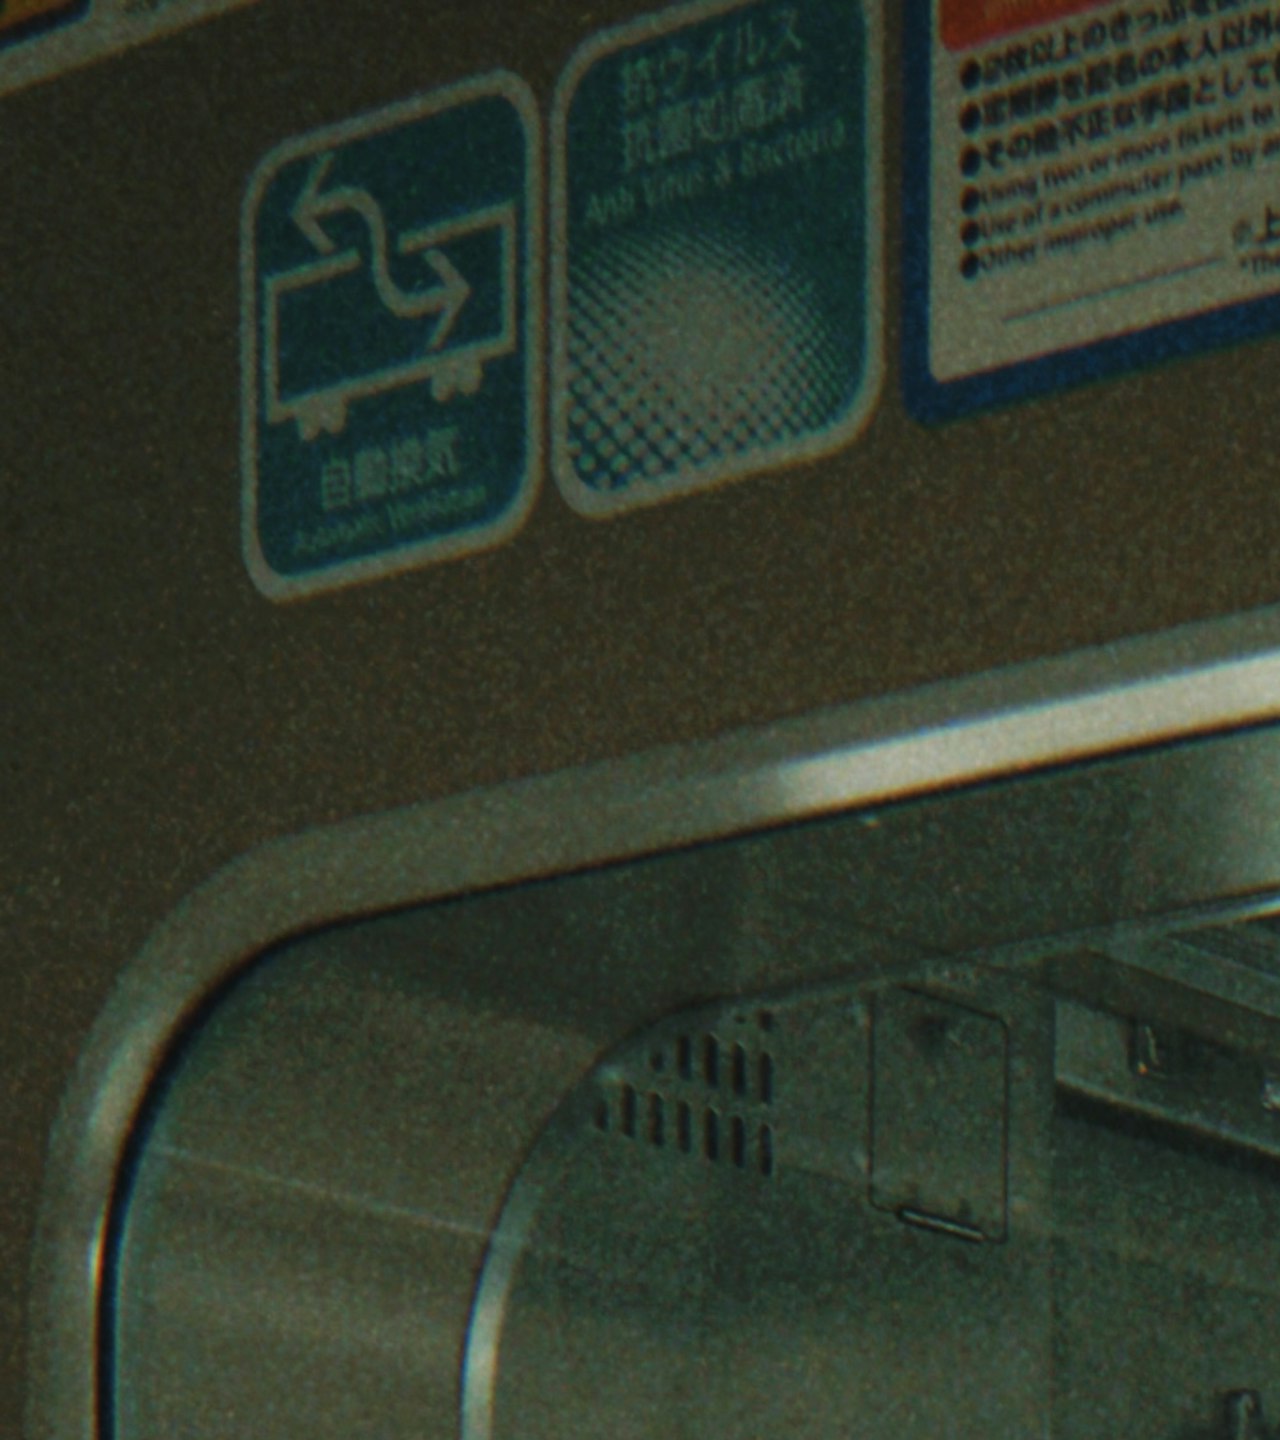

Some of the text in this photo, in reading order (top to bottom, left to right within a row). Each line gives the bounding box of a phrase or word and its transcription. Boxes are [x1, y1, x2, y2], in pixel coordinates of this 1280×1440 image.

[1089, 153, 1110, 174] or
[1116, 136, 1170, 167] more
[1178, 108, 1244, 148] tickets
[1252, 99, 1272, 126] to
[1230, 138, 1253, 170] by
